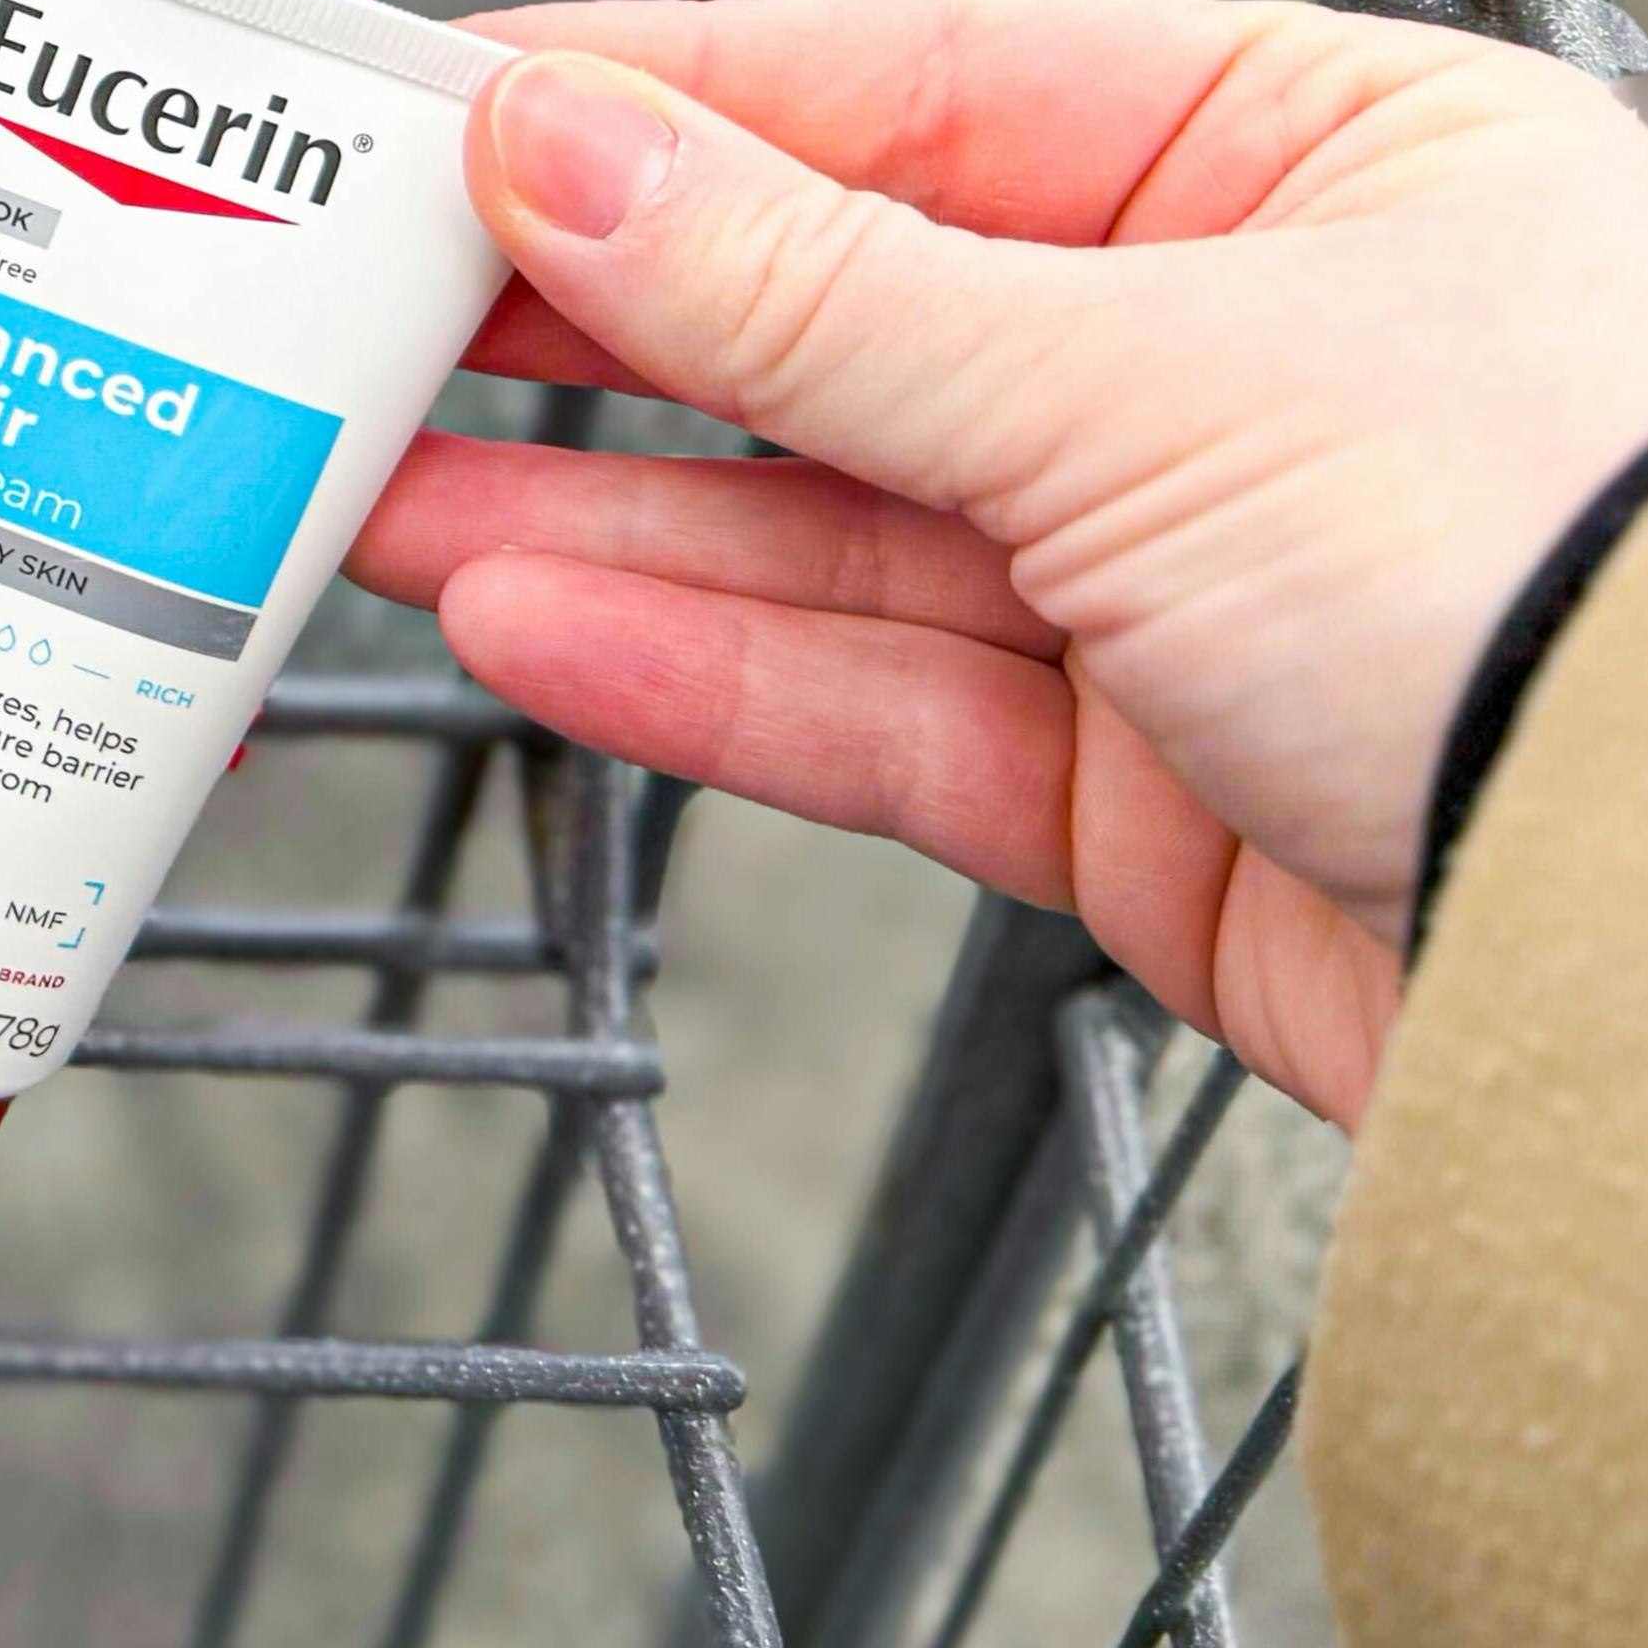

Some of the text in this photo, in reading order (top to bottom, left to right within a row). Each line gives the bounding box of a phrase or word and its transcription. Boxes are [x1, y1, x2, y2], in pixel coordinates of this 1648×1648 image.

[17, 553, 91, 597] SKIN
[135, 678, 197, 712] RICH
[52, 707, 140, 756] helps
[41, 740, 146, 793] barrier
[4, 898, 69, 936] NMF
